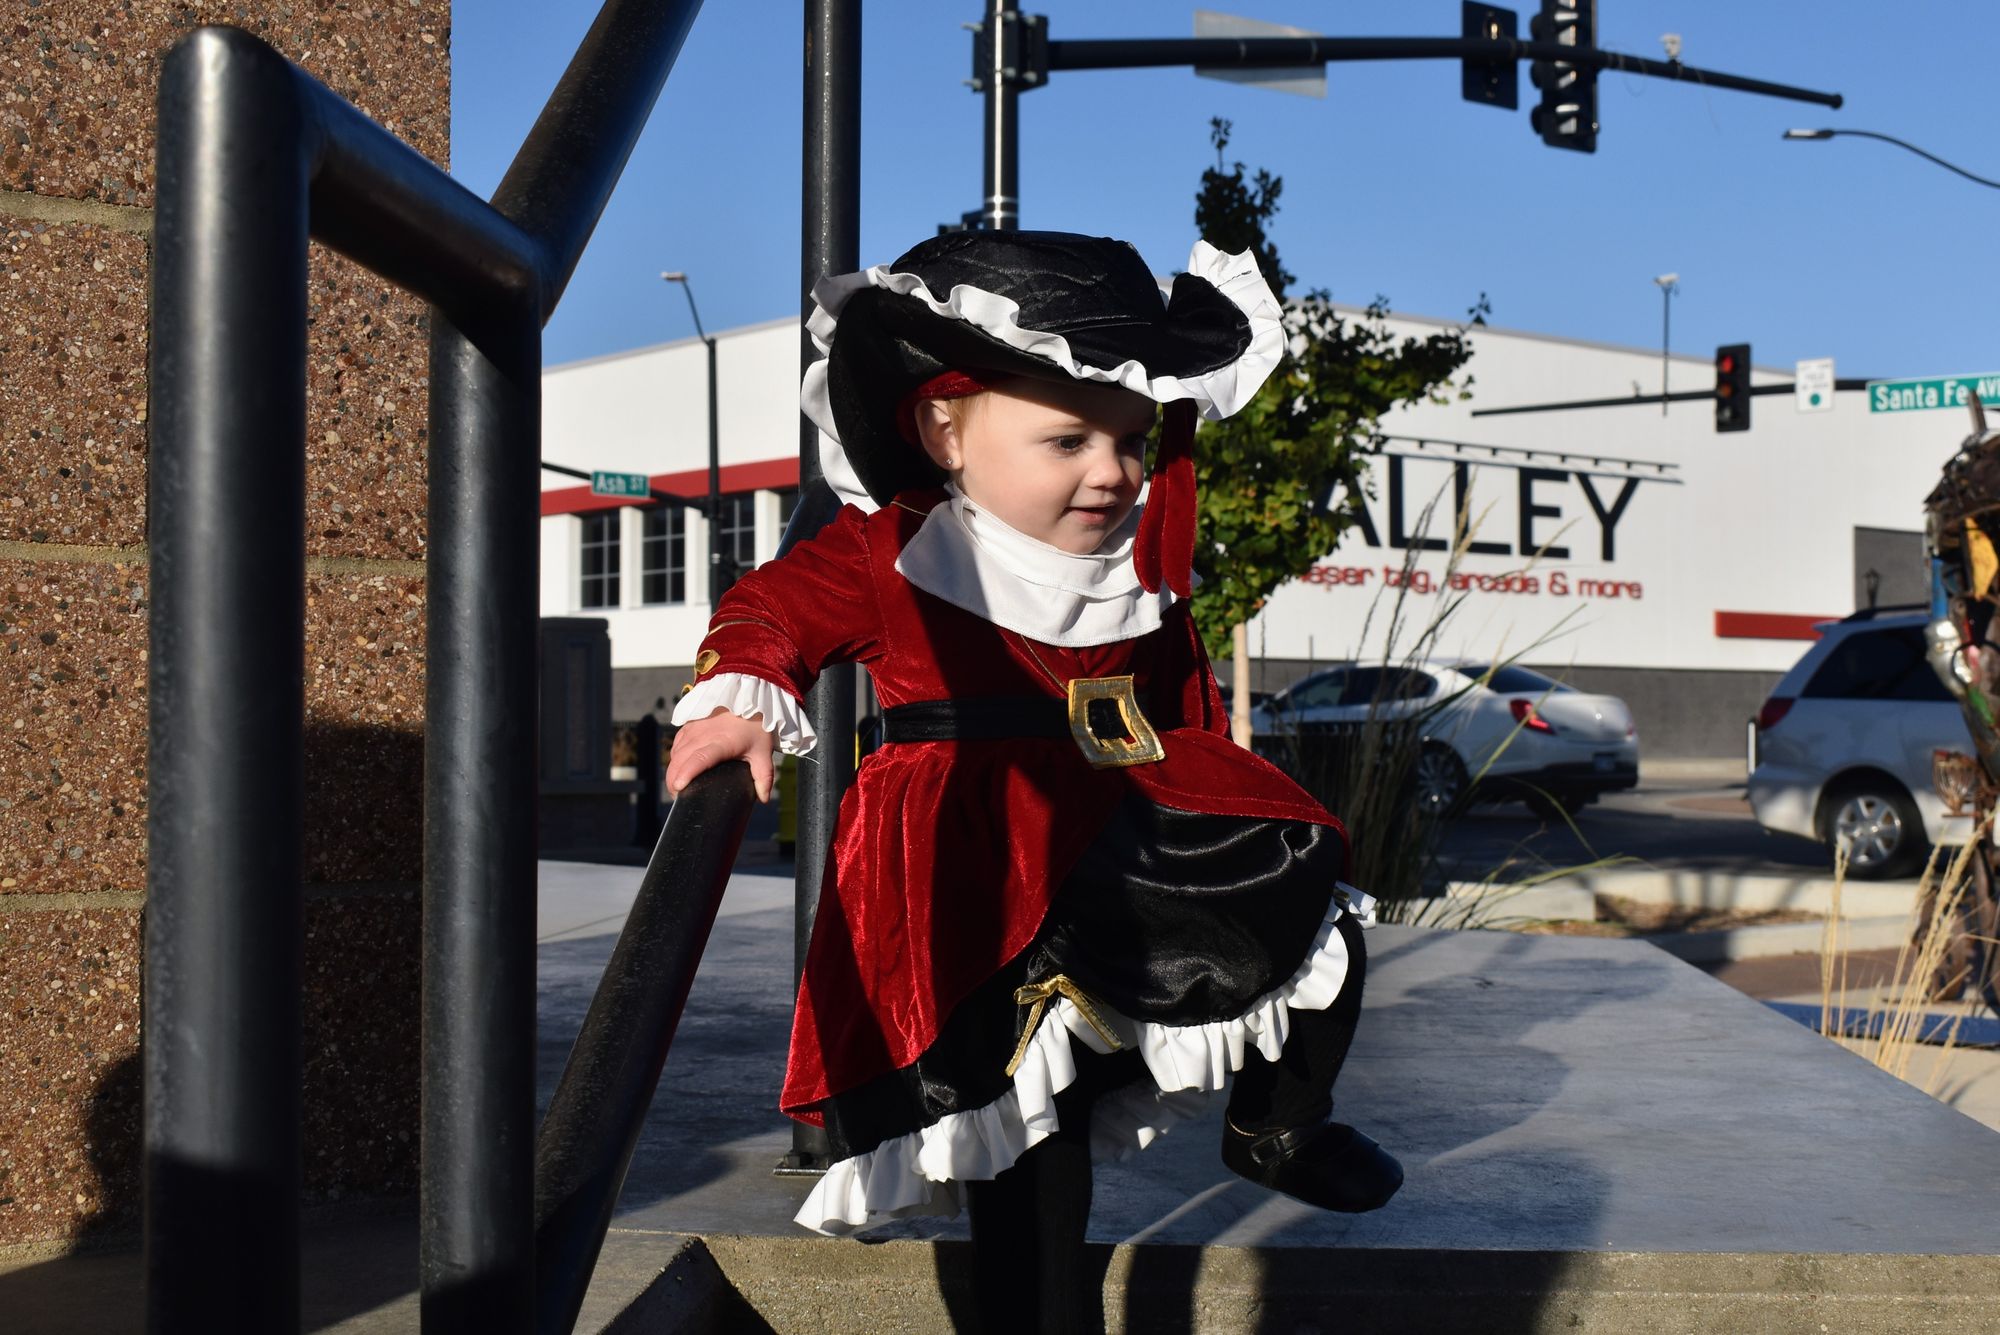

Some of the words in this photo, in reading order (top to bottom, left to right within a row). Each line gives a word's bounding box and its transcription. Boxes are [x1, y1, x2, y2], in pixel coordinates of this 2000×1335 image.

[1875, 384, 1938, 411] Santa
[1944, 380, 1969, 406] Fe
[597, 473, 626, 494] Ash
[1300, 564, 1374, 586] aser
[1448, 571, 1540, 594] arcade
[1549, 570, 1569, 596] &
[1578, 577, 1643, 599] more
